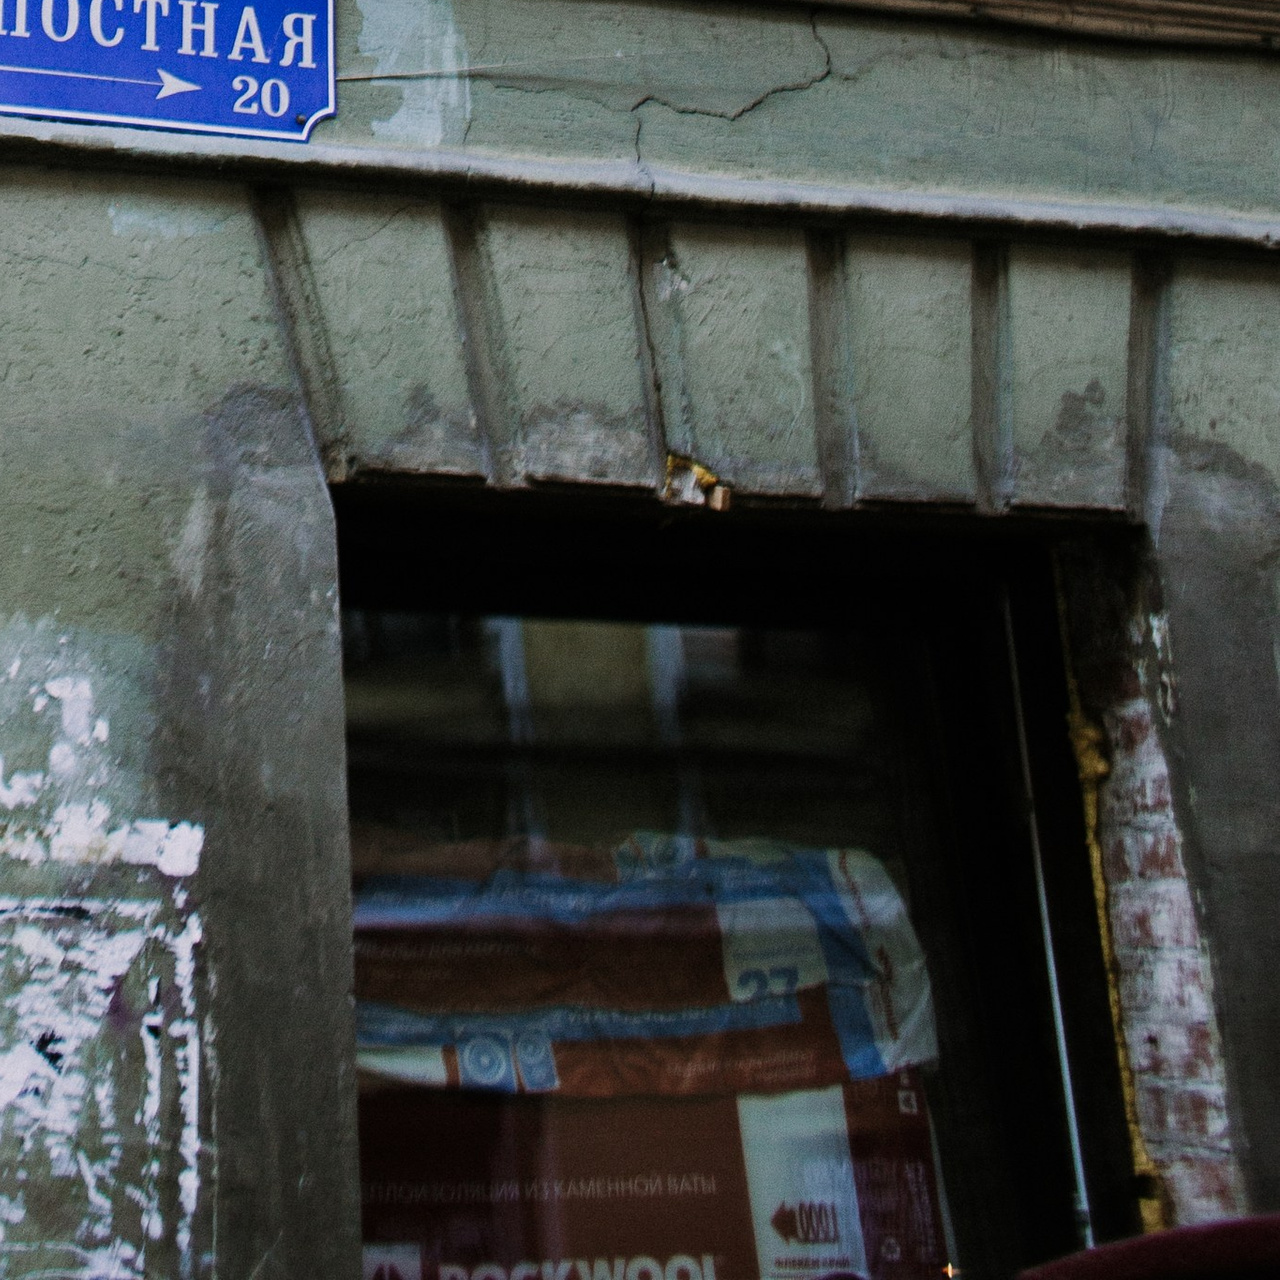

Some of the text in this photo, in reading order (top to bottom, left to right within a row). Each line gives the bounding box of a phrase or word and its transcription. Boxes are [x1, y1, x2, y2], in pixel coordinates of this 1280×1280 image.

[232, 75, 291, 118] 20
[553, 1171, 663, 1200] КАМЕННОЙ
[667, 1173, 718, 1196] ВАТЫ
